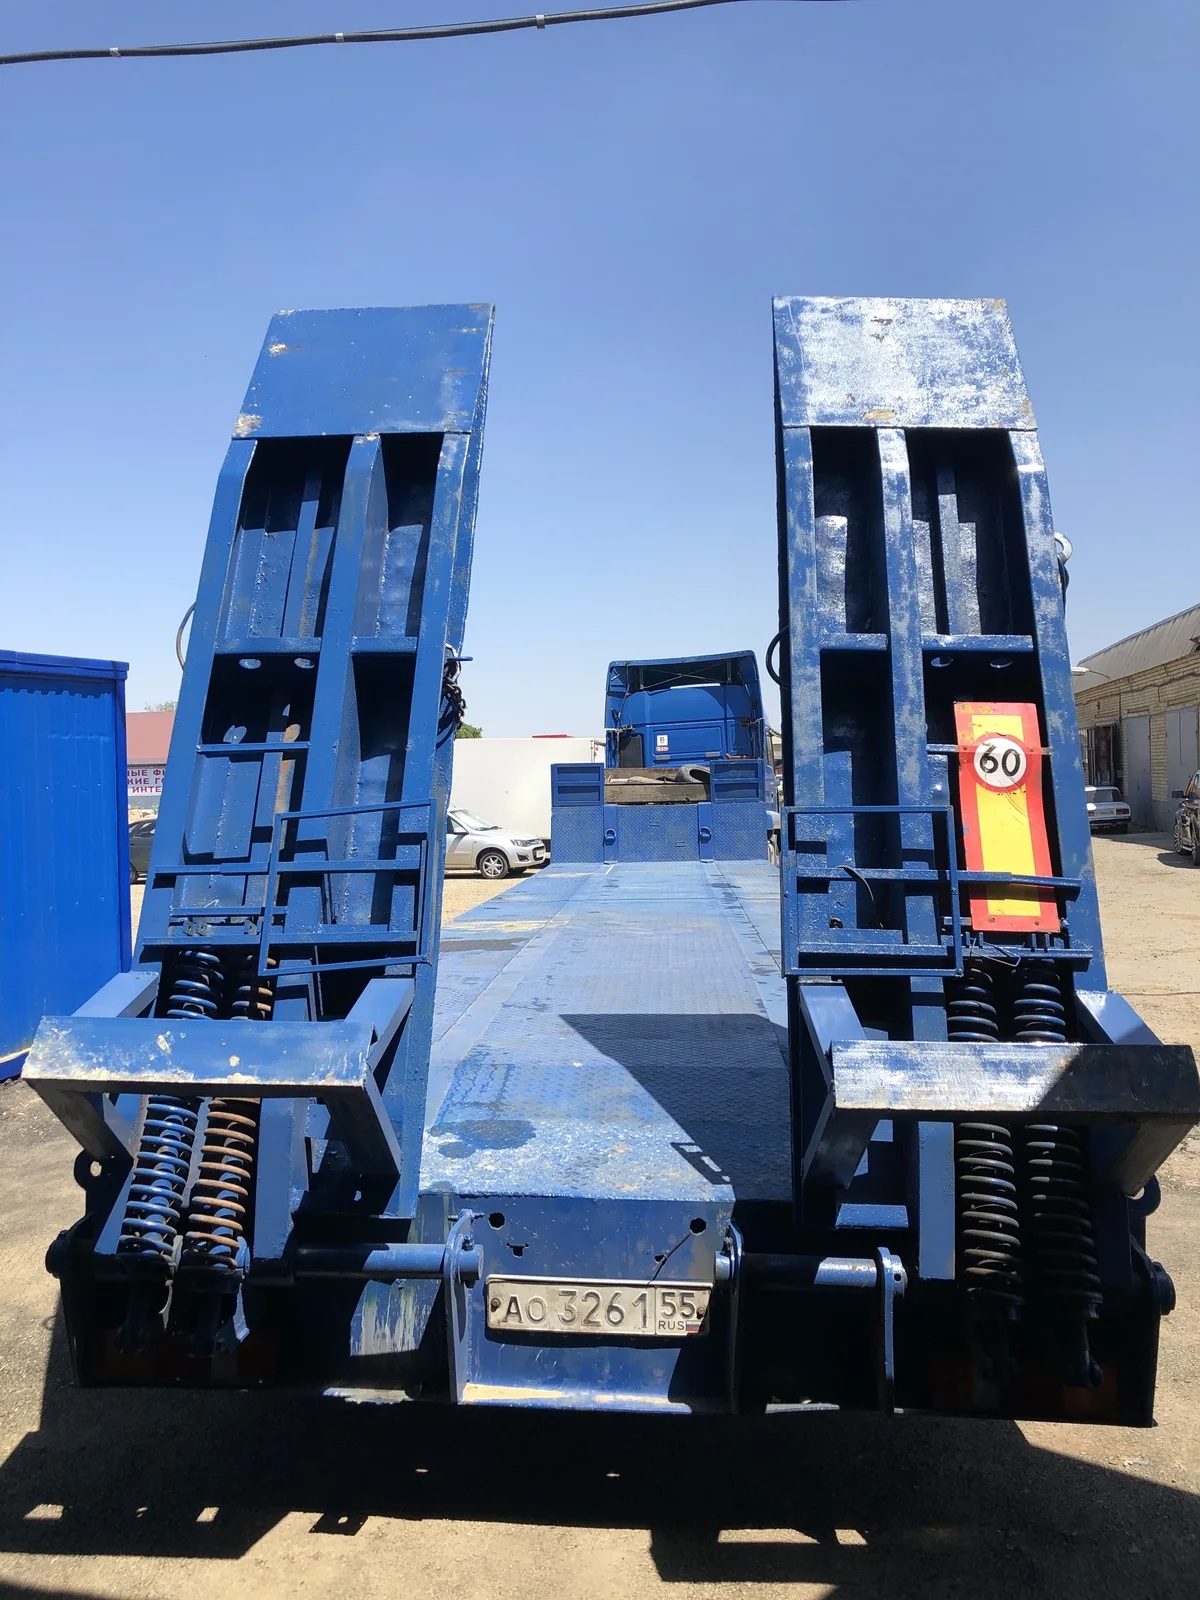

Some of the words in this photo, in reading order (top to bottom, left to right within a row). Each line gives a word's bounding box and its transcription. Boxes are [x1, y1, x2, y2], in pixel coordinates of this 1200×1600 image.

[979, 745, 1021, 777] 60
[557, 1288, 649, 1329] 3261
[660, 1291, 696, 1320] 55
[657, 1320, 685, 1331] RUS
